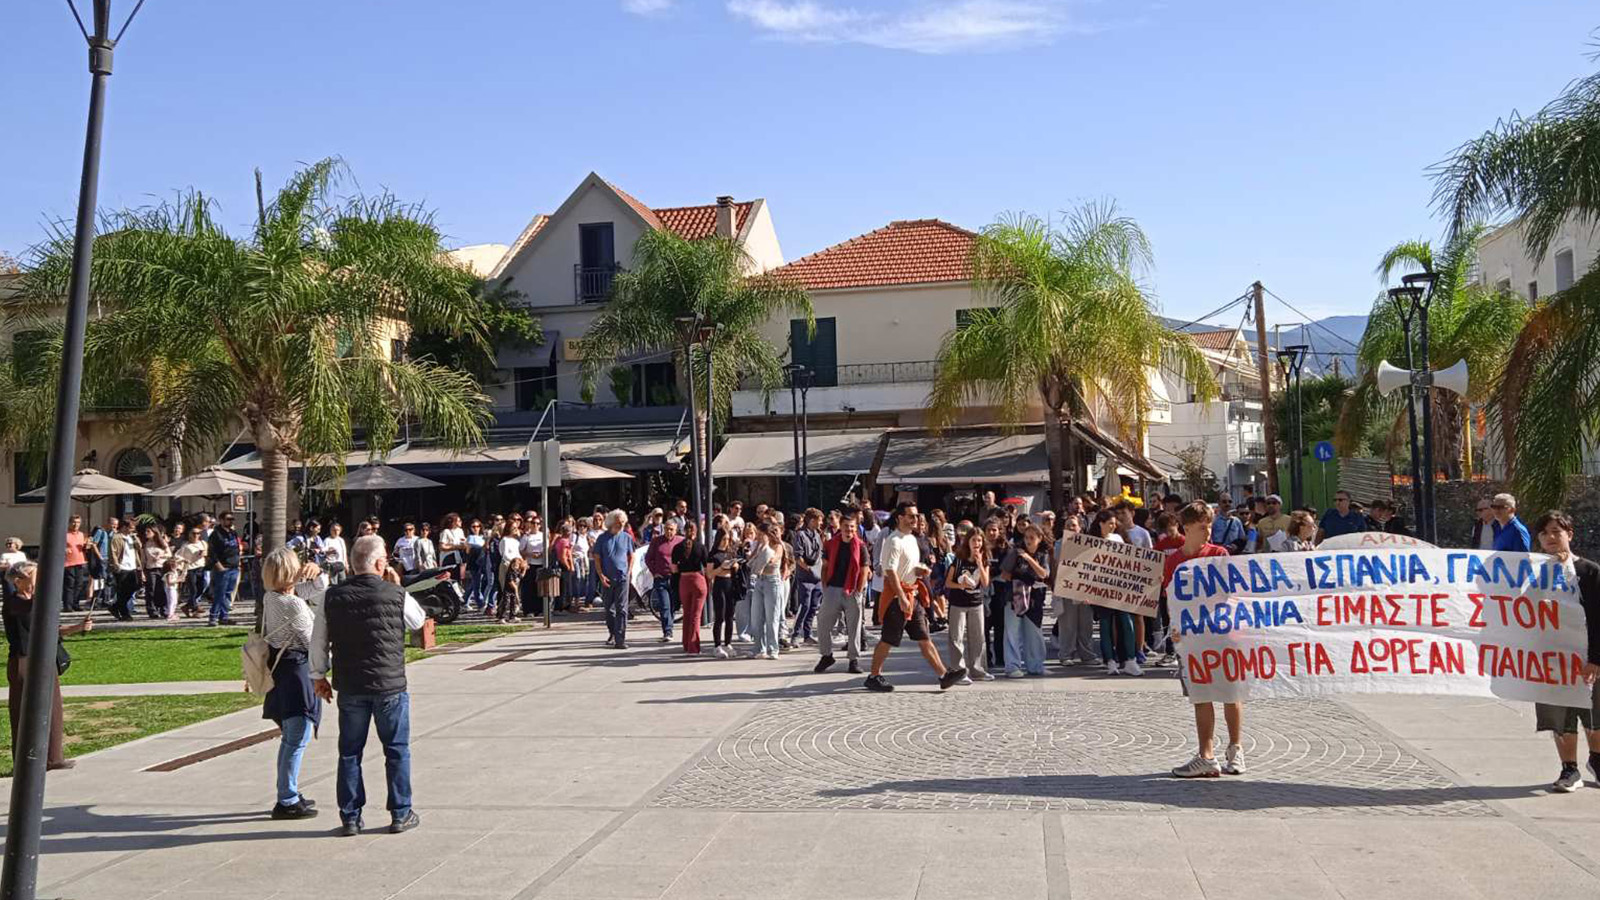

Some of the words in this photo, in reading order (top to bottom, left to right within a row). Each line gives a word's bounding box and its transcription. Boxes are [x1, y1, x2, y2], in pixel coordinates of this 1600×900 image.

[1084, 537, 1132, 556] ΜΟΡΦΩΣΗ
[1135, 548, 1163, 563] ΕΙΝΑΙ
[1061, 559, 1079, 568] ΔΕΝ
[1092, 574, 1145, 594] ΔΙΕΚΔΙΚΟΥΜΕ
[1174, 558, 1302, 601] ΕΛΛΑΔΑ,
[1305, 553, 1439, 590] ΙΣΠΑΝΙΑ,
[1447, 553, 1576, 594] ΓΑΛΛΙΑ,
[1076, 582, 1123, 601] ΓΥΜΝΑΣΙΟ
[1180, 600, 1303, 636] ΑΛΒΑΝΙΑ
[1316, 593, 1450, 628] ΕΙΜΑΣΤΕ
[1469, 593, 1561, 631] ΣΤΟΝ
[1187, 645, 1277, 685] ΔΡΟΜΟ
[1288, 642, 1335, 677] ΓΙΑ
[1350, 638, 1465, 675] ΔΩΡΕΑΝ
[1478, 643, 1586, 686] ΠΑΙΔΕΙΑ
